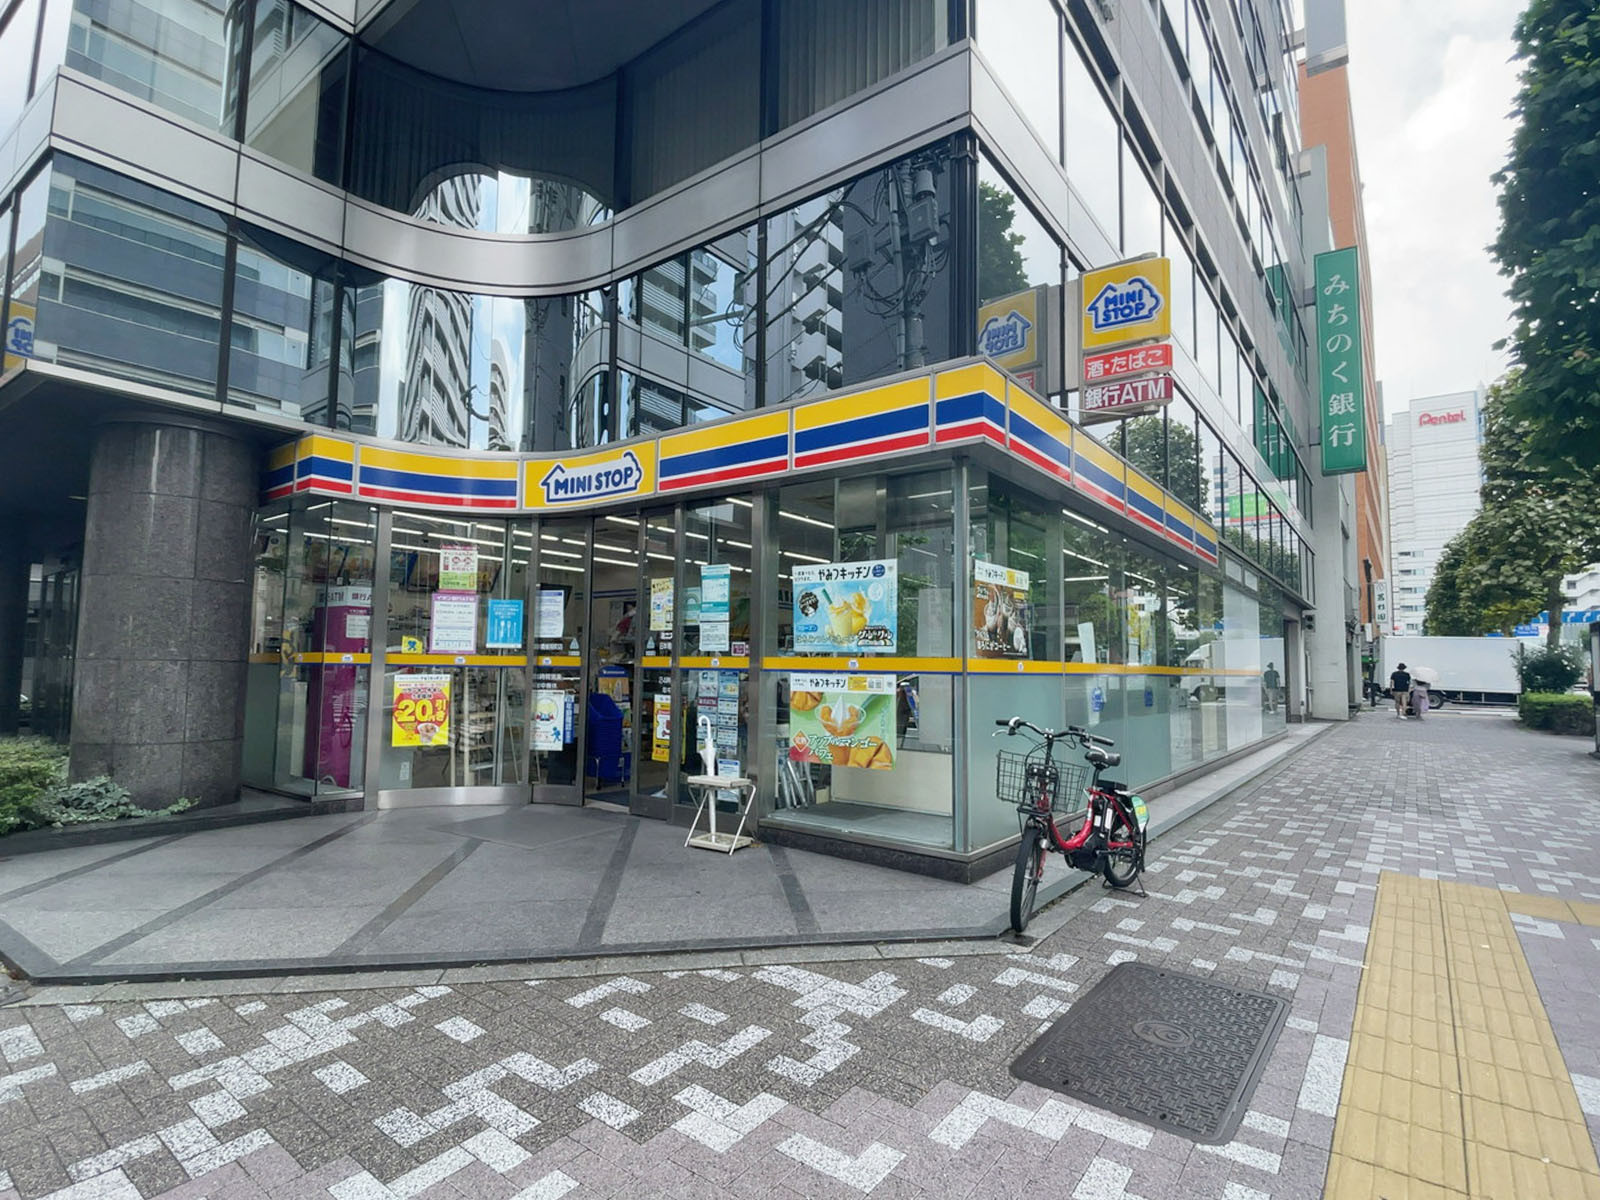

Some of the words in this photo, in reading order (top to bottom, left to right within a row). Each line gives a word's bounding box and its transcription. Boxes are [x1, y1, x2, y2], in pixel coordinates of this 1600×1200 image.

[1104, 289, 1143, 309] MINI
[1102, 302, 1146, 322] STOP
[1087, 350, 1163, 379] 酒・たばこ
[1323, 274, 1357, 448] みちのく銀行
[1085, 379, 1165, 409] 銀行ATM
[554, 475, 592, 495] MINI
[595, 466, 634, 491] STOP
[818, 566, 871, 581] やみつキッチン
[809, 678, 846, 689] やみつキッチン
